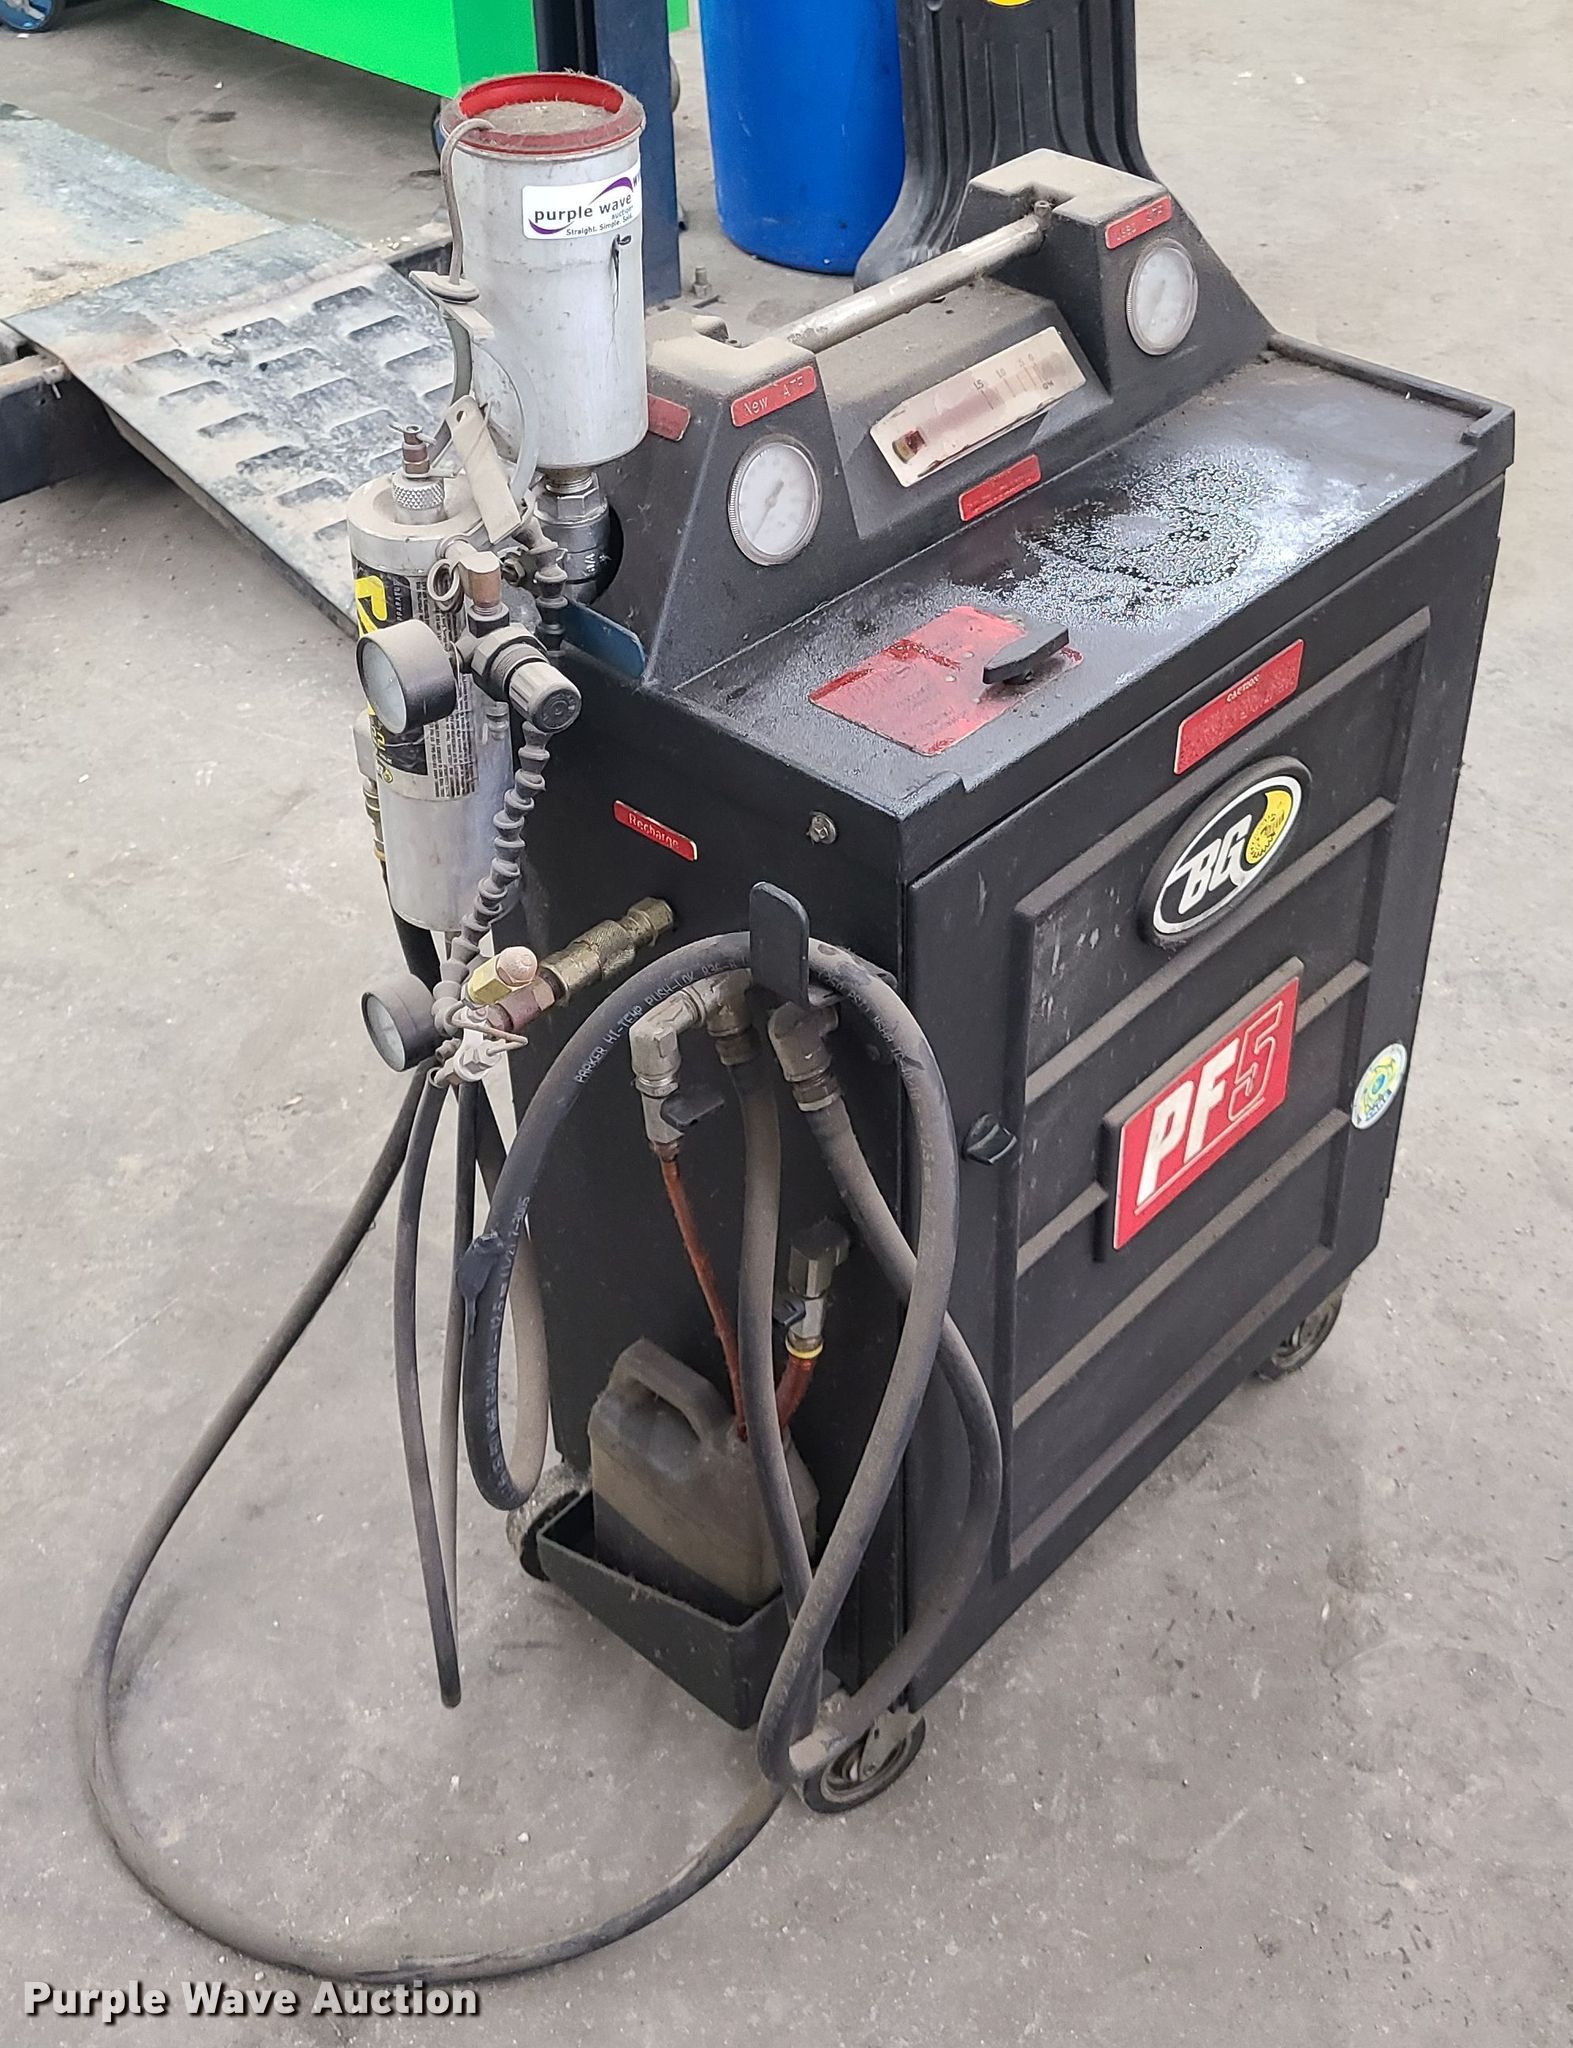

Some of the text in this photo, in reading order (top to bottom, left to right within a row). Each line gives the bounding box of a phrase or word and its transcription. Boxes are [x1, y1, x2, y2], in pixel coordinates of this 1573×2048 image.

[535, 194, 632, 223] purple wave
[628, 812, 680, 849] Recharge
[1173, 813, 1253, 915] BG
[574, 1045, 608, 1084] PARKER
[1136, 999, 1284, 1207] PF5
